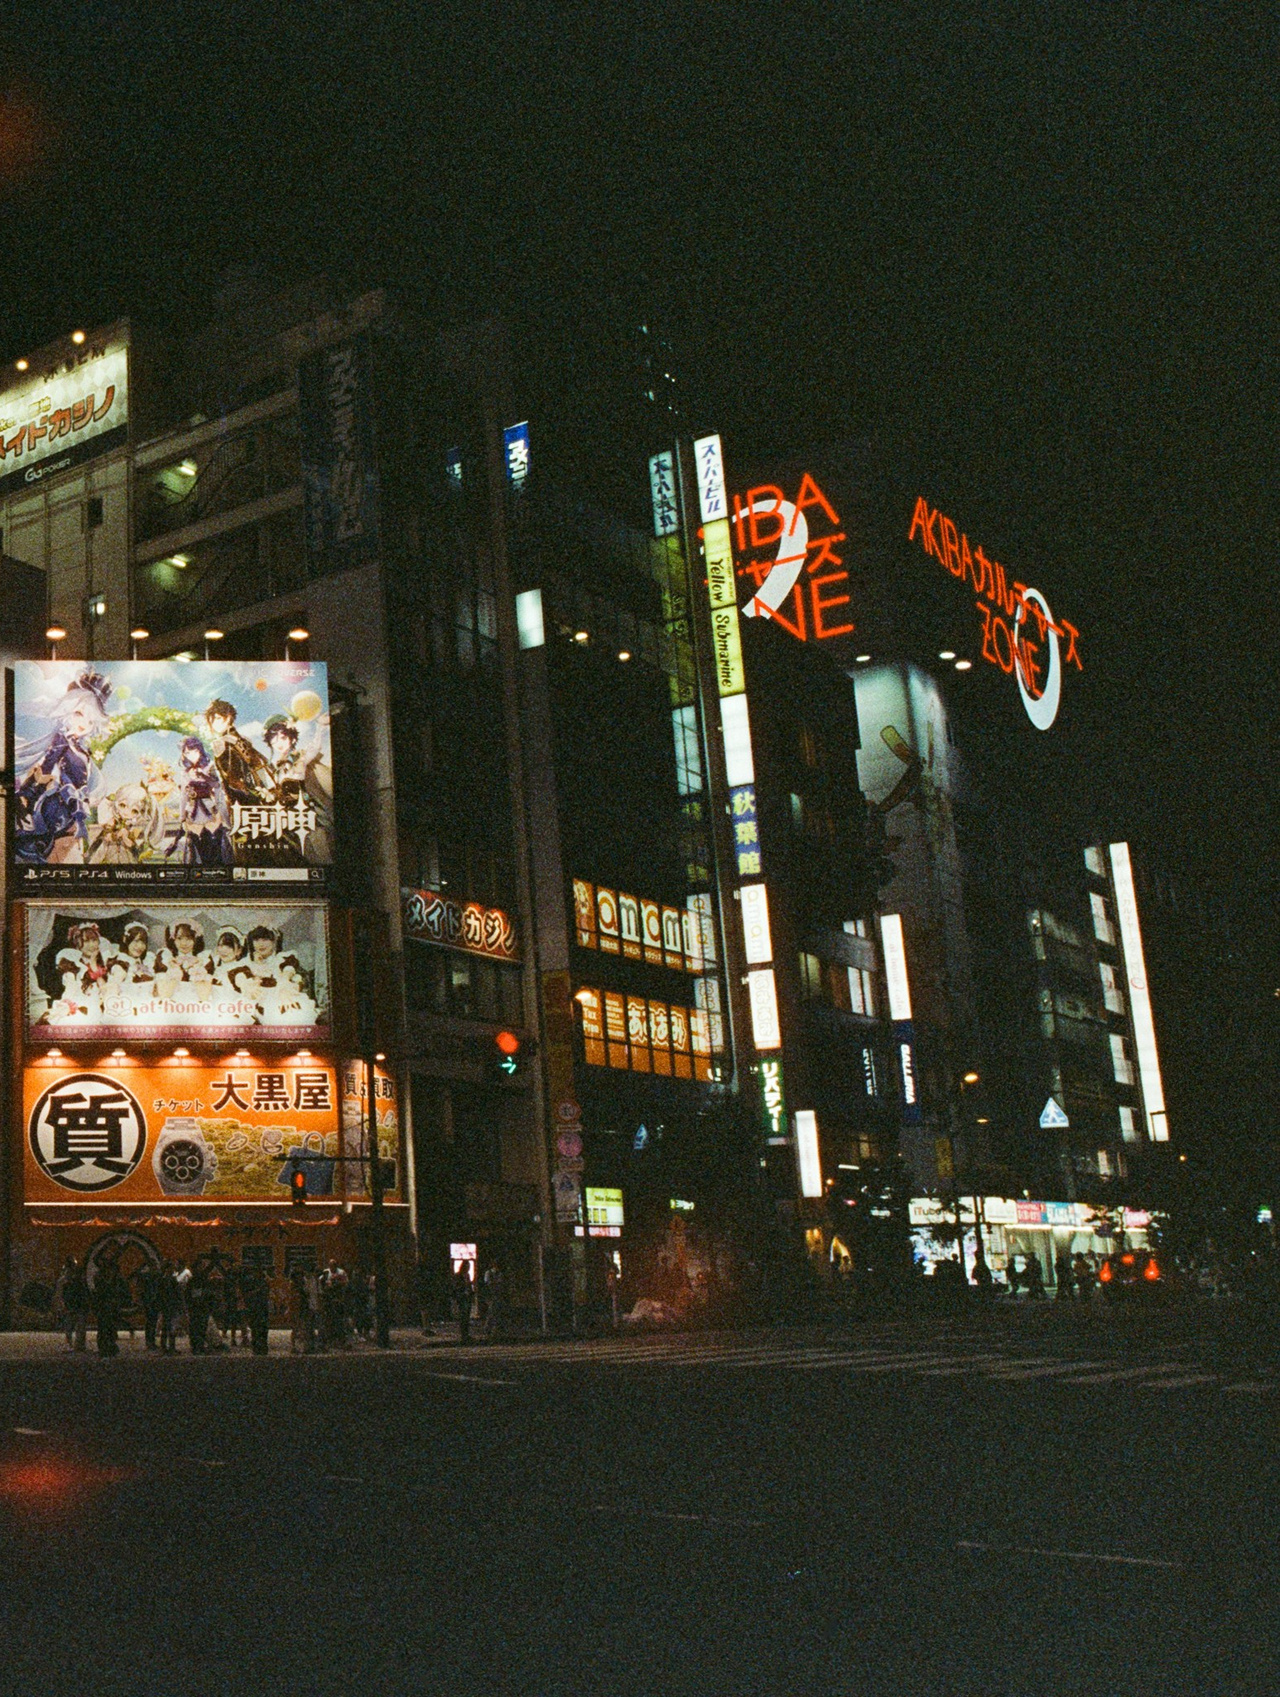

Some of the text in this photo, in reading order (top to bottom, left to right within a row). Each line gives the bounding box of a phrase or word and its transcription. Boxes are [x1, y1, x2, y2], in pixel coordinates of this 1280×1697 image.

[702, 443, 721, 513] スーパービル
[715, 614, 732, 688] Submarine
[230, 790, 317, 857] 原神
[732, 791, 762, 877] 秋葉館
[40, 869, 152, 879] PS5 PS4 Windows
[218, 1000, 253, 1013] cafe
[153, 1098, 205, 1112] チケット
[211, 1072, 332, 1112] 大黒屋
[43, 1090, 137, 1179] 質
